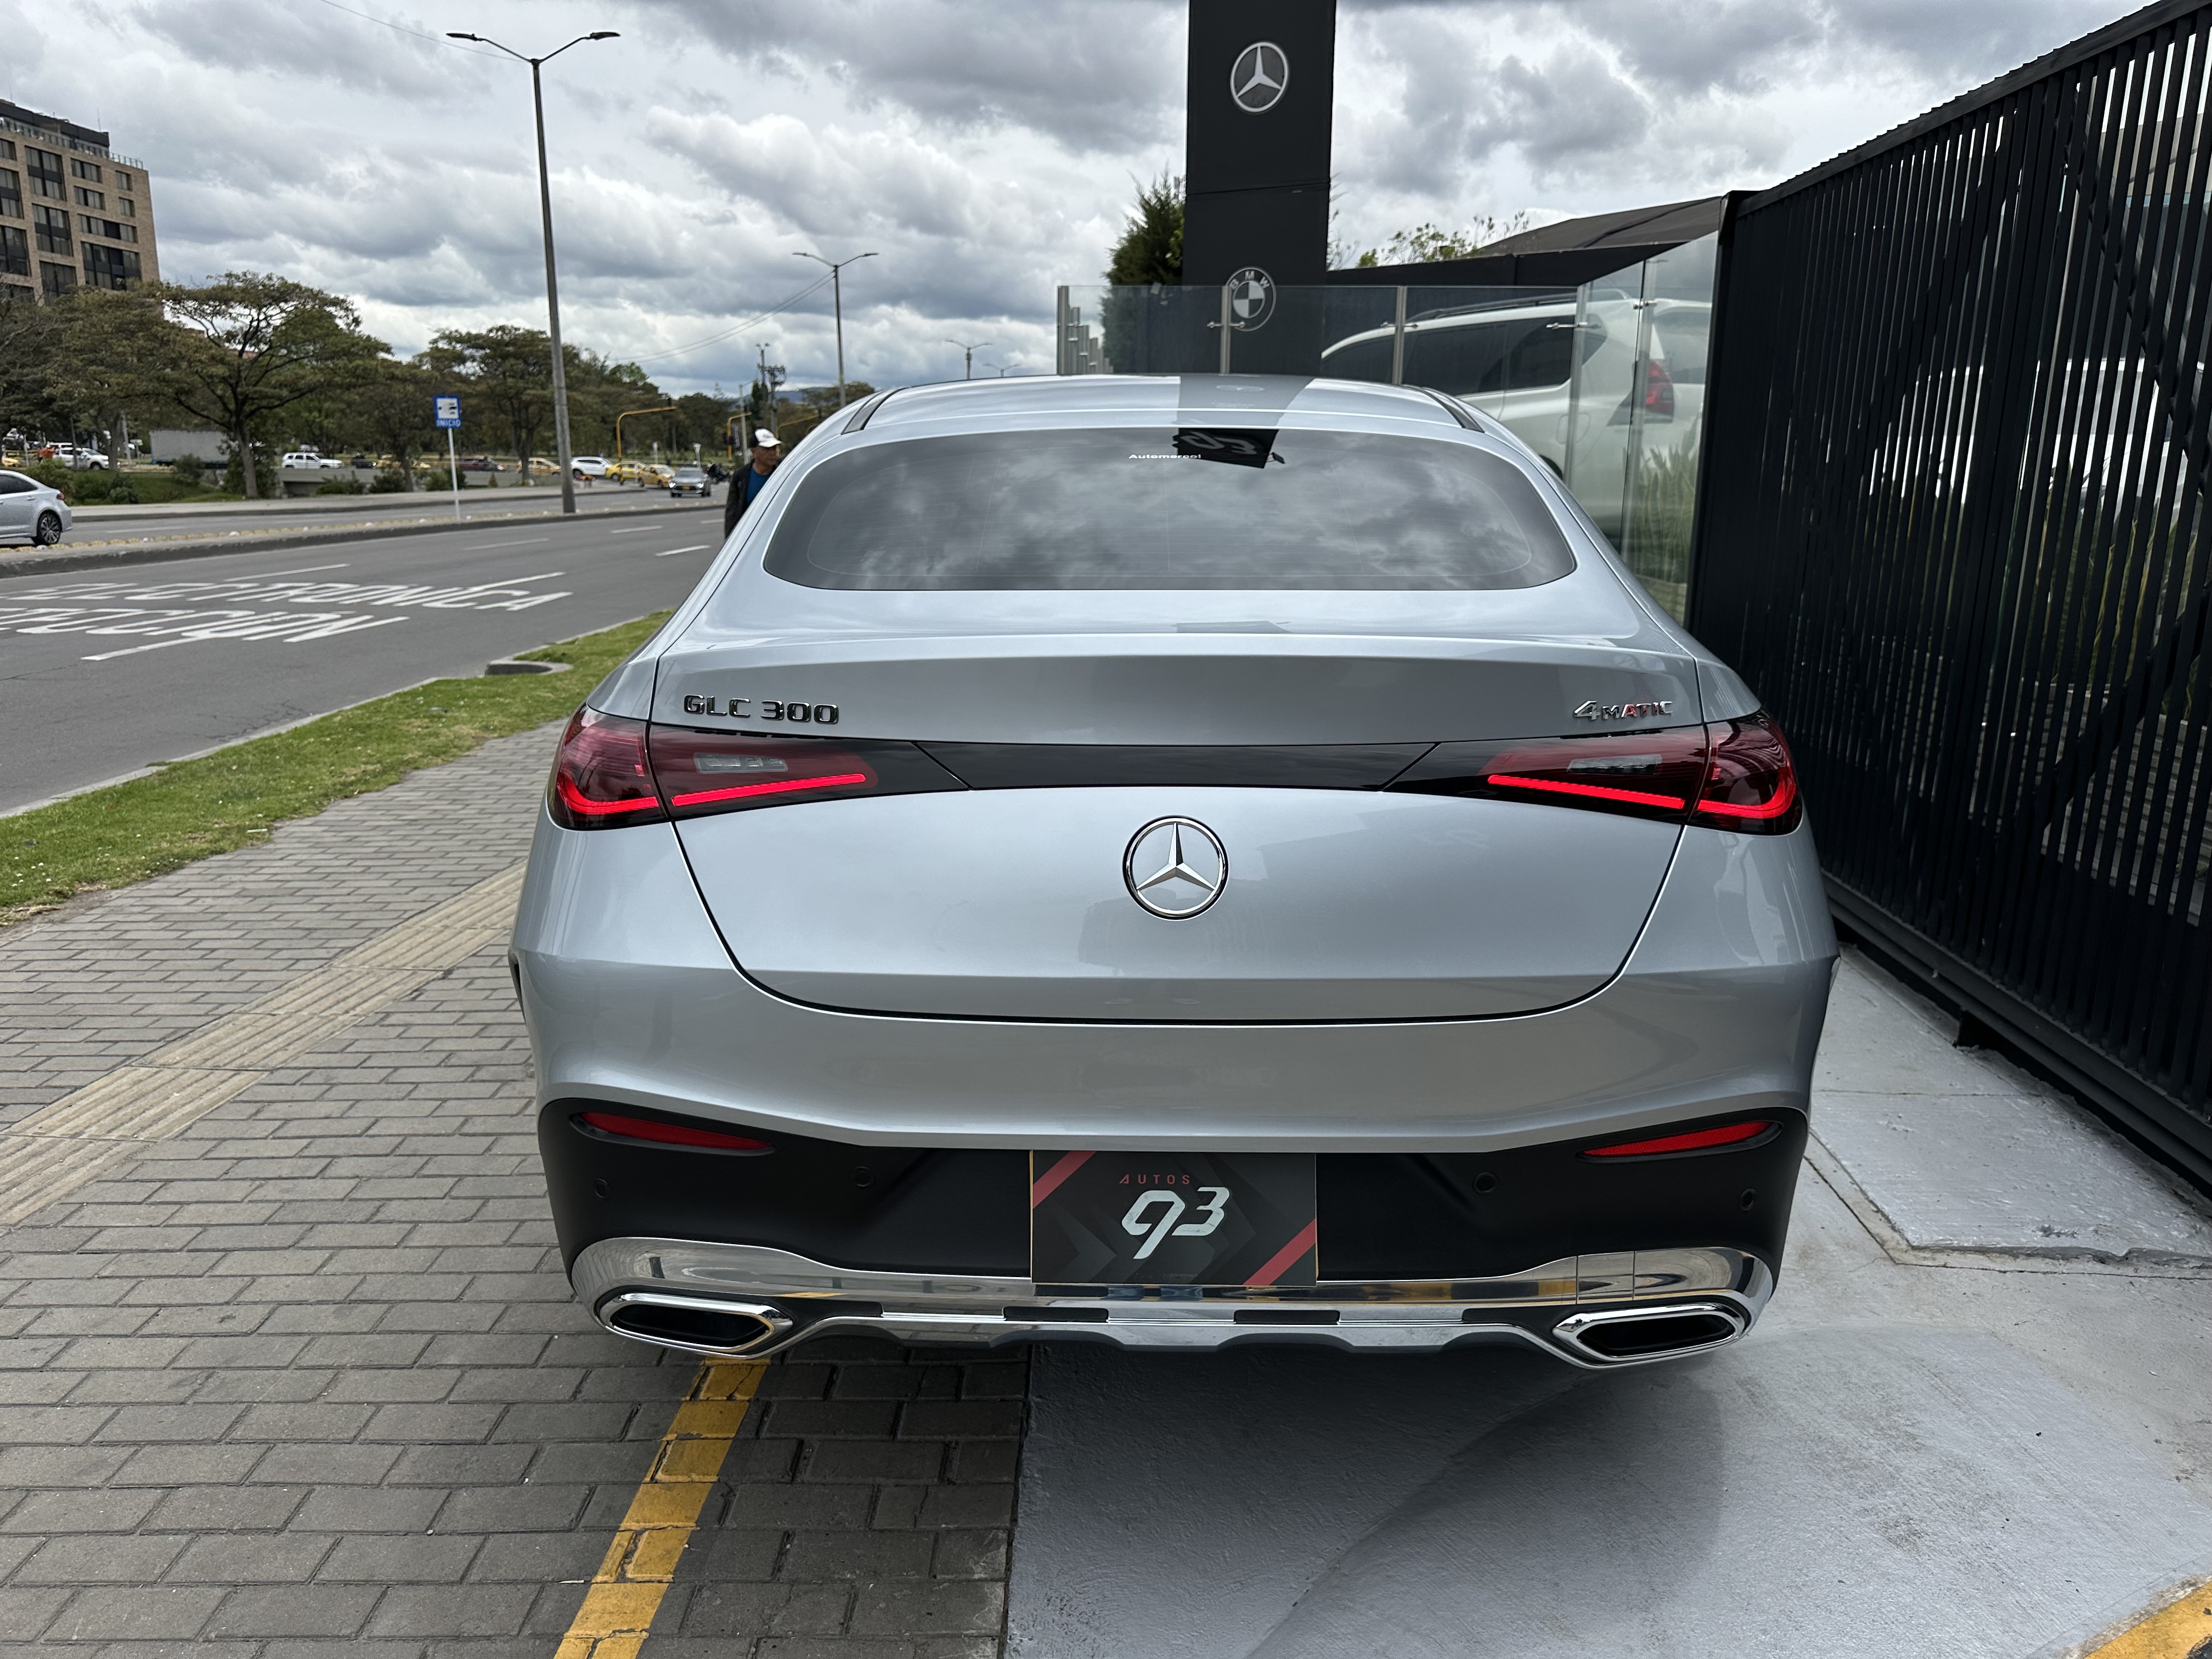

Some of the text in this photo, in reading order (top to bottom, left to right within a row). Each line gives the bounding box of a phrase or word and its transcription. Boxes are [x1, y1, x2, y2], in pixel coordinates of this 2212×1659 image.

[1229, 270, 1271, 290] BMW
[436, 419, 461, 427] INICIO
[684, 693, 839, 724] GLC 300
[1573, 700, 1673, 720] 4MATIC
[1119, 1174, 1190, 1184] AUTOS
[1121, 1186, 1230, 1260] 93
